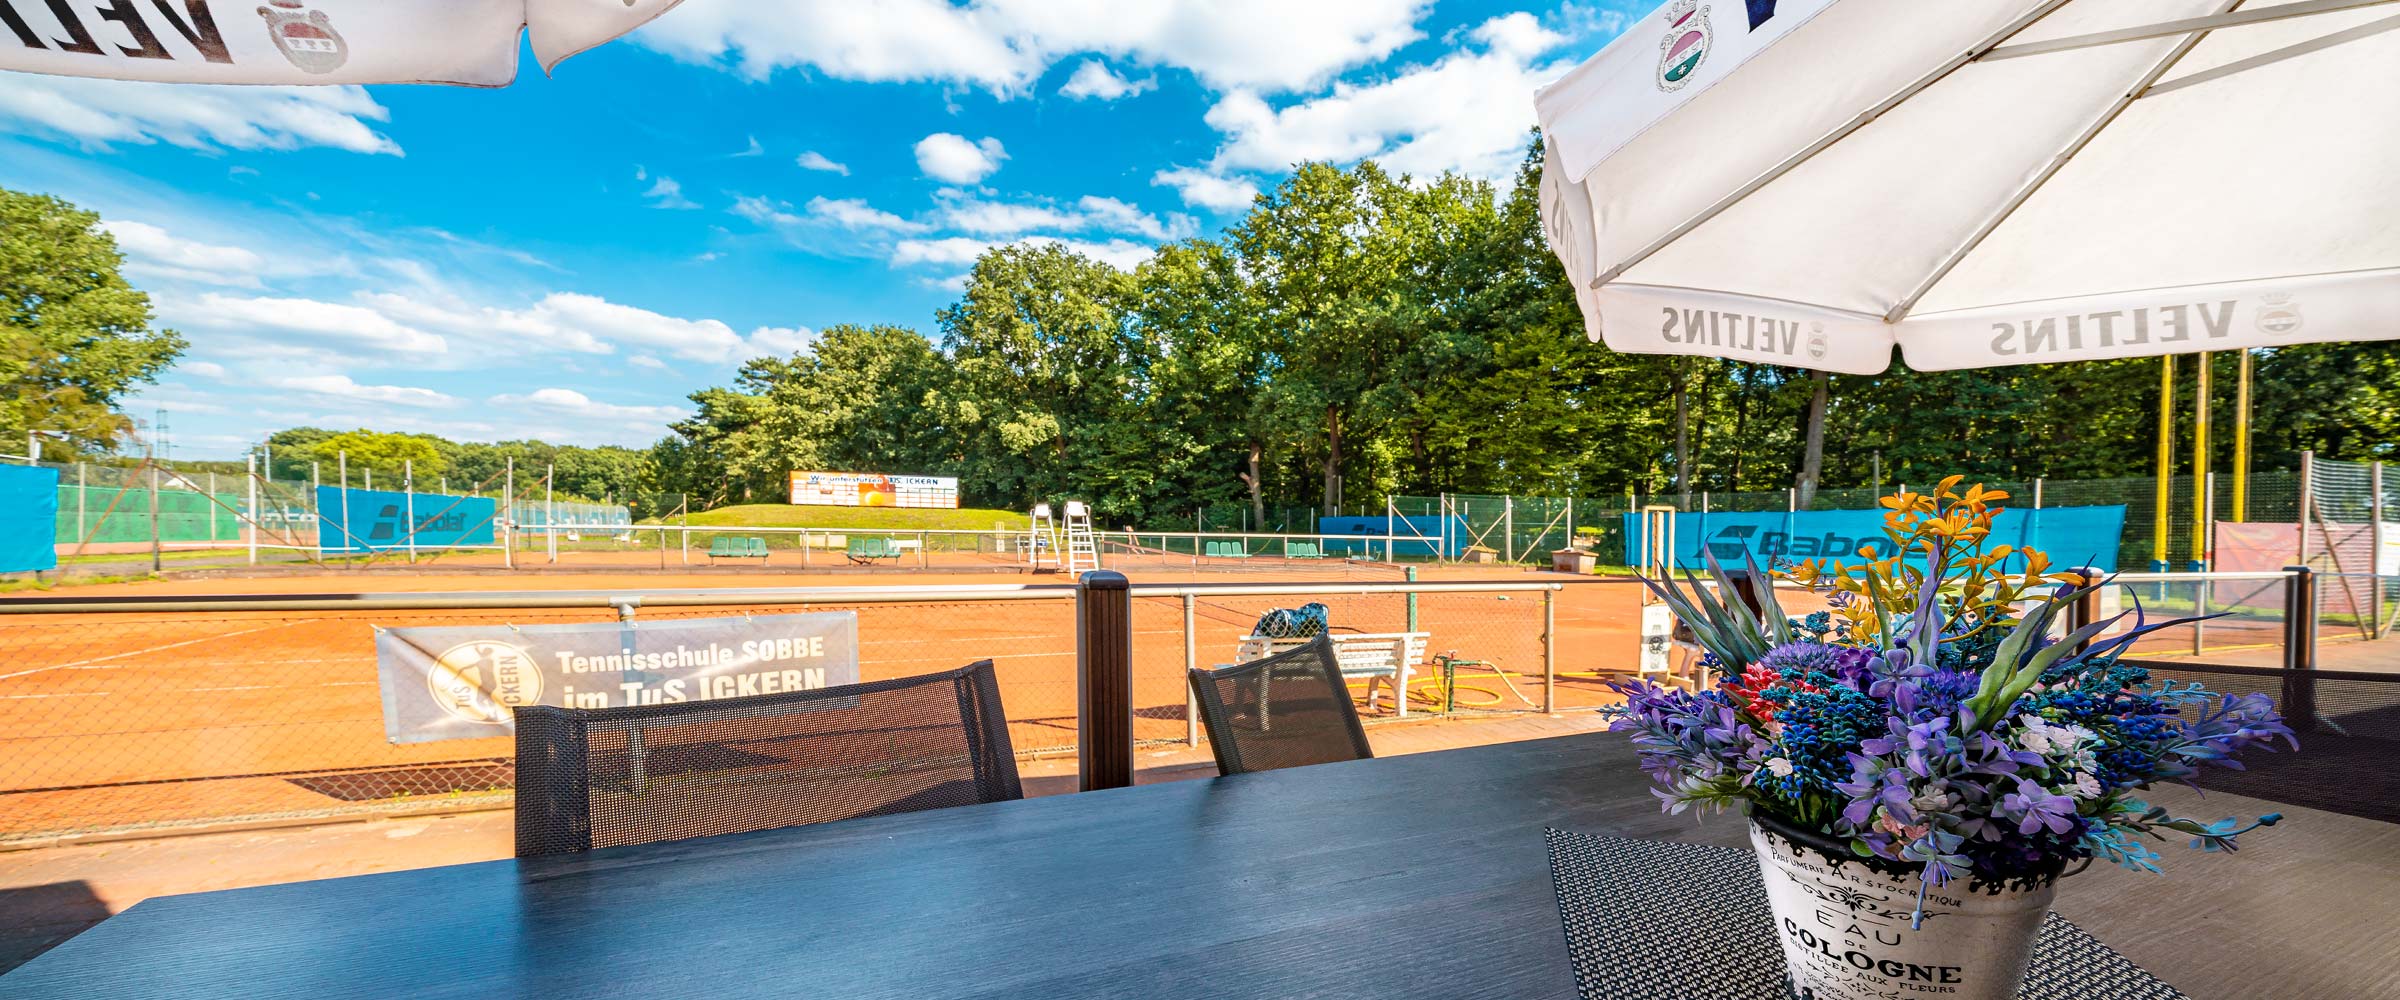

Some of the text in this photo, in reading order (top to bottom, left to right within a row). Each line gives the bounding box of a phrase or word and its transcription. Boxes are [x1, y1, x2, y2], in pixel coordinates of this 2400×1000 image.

[1758, 532, 1937, 559] Babol
[556, 636, 824, 674] Tennisschule SOBBE
[563, 668, 825, 709] im TuS ICKERN
[1770, 847, 1824, 875] PARFUMERIE
[1816, 909, 1901, 946] EAU
[1784, 917, 1962, 984] COLOGNE
[1845, 939, 1867, 950] DE
[1856, 972, 1888, 985] AUX
[1899, 982, 1956, 993] FLEURS
